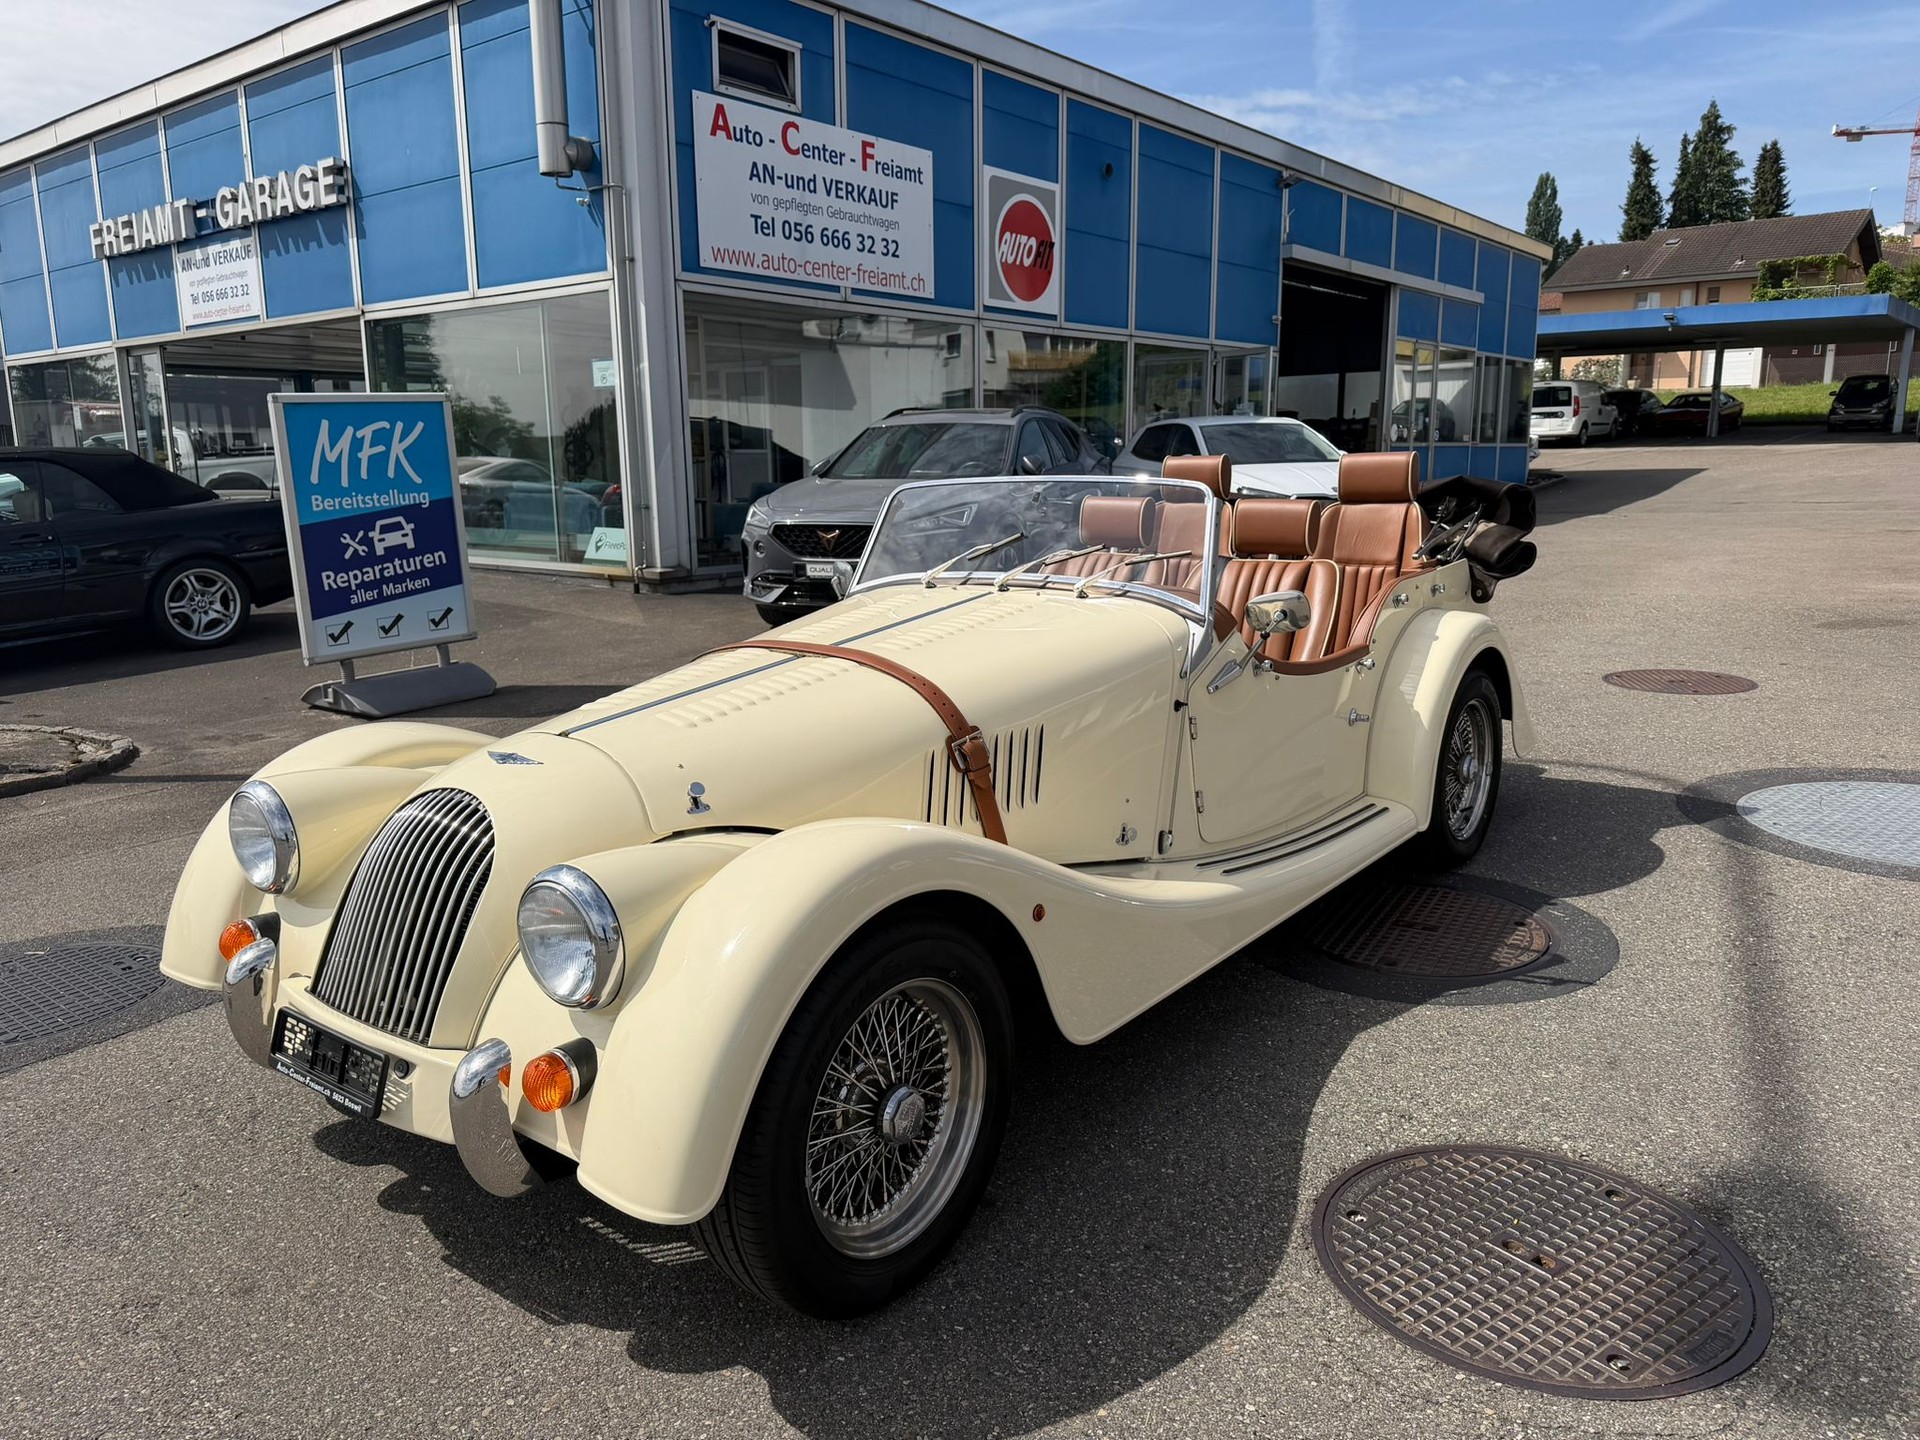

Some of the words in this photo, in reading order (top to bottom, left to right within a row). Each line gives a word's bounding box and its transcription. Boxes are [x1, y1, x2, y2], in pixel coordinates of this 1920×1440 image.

[709, 103, 763, 147] Auto
[781, 120, 846, 166] Center
[861, 139, 923, 185] Freiamt
[749, 161, 817, 195] AN-und
[822, 176, 899, 210] VERKAUF
[89, 197, 194, 259] FREIAMT
[215, 156, 346, 230] GARAGE
[751, 192, 770, 206] von
[773, 196, 824, 217] gepflegten
[827, 206, 900, 231] Gebrauchtwagen
[750, 213, 776, 237] Tel
[782, 219, 814, 244] 056
[820, 227, 851, 250] 666
[856, 233, 876, 254] 32
[881, 238, 900, 258] 32
[181, 253, 211, 273] AN-und
[212, 244, 252, 266] VERKAUF
[711, 246, 926, 293] www.auto-center-freiamt.ch
[191, 293, 200, 305] Tel
[202, 290, 214, 303] 056
[216, 287, 228, 301] 666
[230, 285, 239, 299] 32
[240, 283, 250, 297] 32
[310, 419, 424, 488] MFK
[311, 489, 429, 512] Bereitstellung
[321, 549, 447, 591] Reparaturen
[350, 586, 379, 605] aller
[383, 575, 430, 598] Marken
